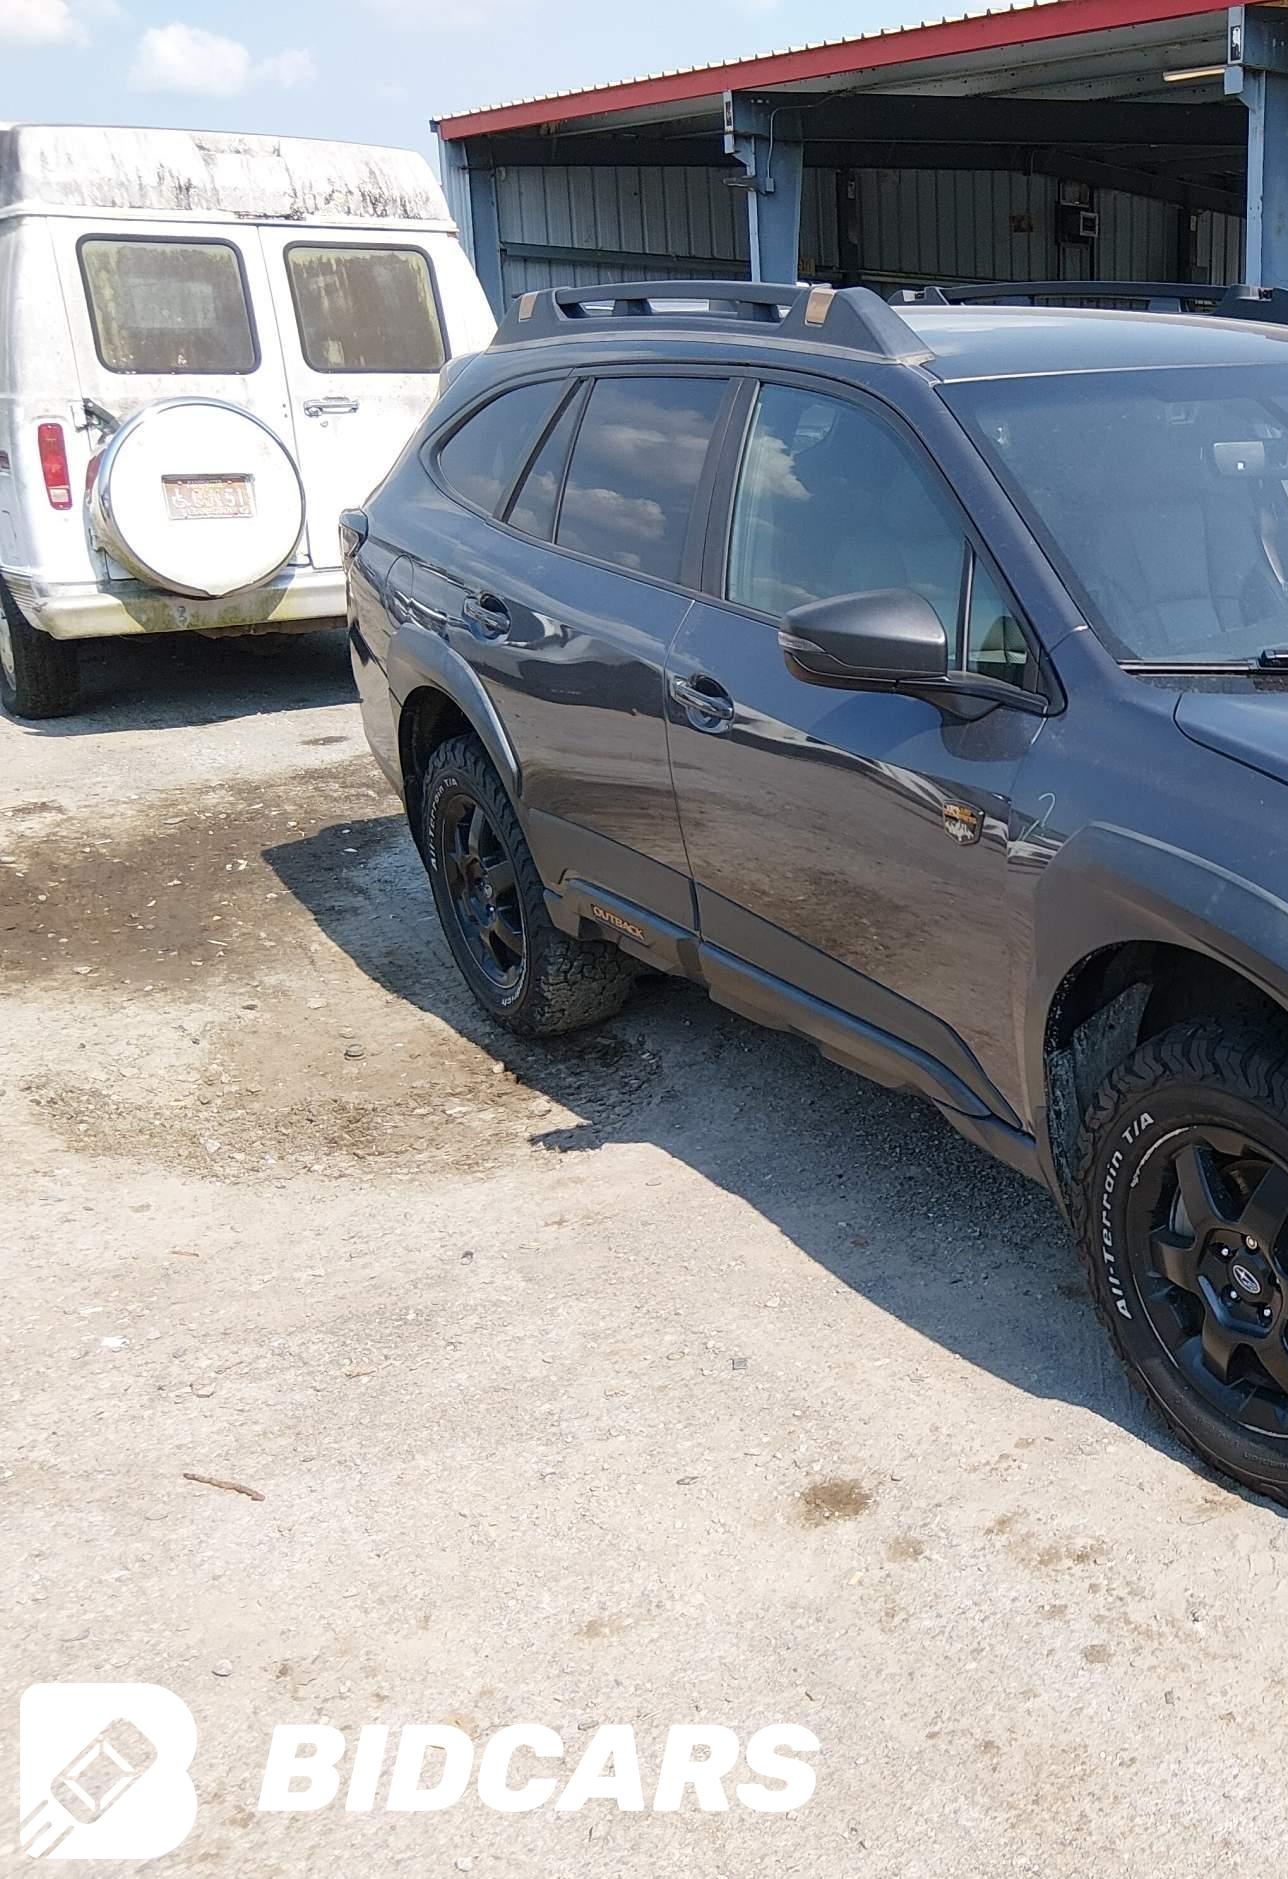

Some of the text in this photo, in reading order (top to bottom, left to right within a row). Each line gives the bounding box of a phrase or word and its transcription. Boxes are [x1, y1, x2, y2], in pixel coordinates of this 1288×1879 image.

[428, 778, 458, 872] All-Terrain T/A
[593, 906, 645, 940] OUTBACK
[1102, 1112, 1155, 1320] All-Terrain T/A
